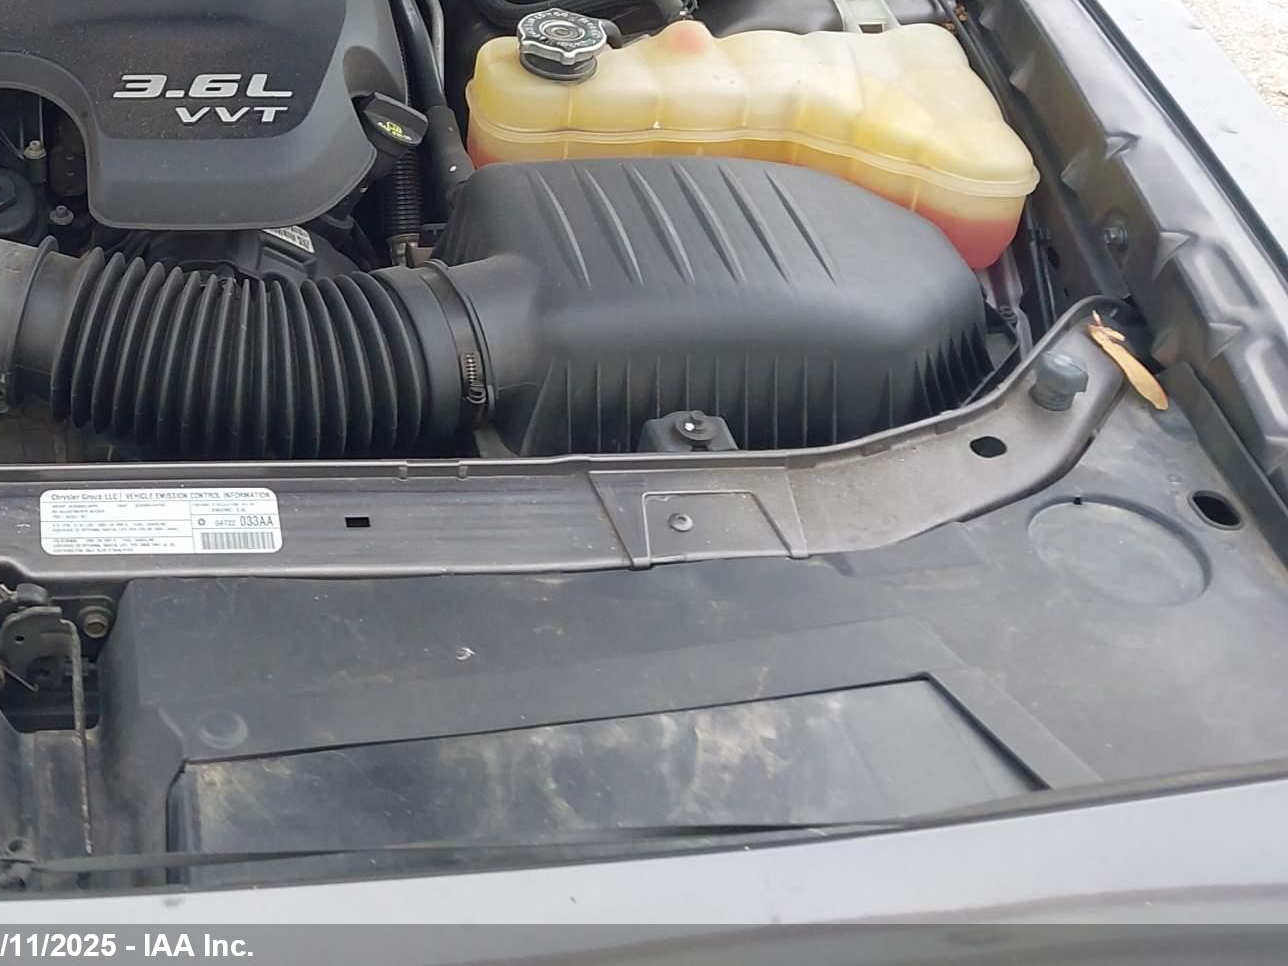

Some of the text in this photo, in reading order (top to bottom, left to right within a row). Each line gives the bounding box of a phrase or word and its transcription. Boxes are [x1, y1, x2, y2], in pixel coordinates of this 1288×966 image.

[112, 74, 293, 98] 3.6L
[175, 107, 289, 123] VVT
[50, 493, 80, 501] Chrysler
[81, 493, 102, 501] Group
[126, 490, 271, 500] VEHICLE EMISSION CONTROL INFORMATION
[239, 515, 274, 526] 033AA
